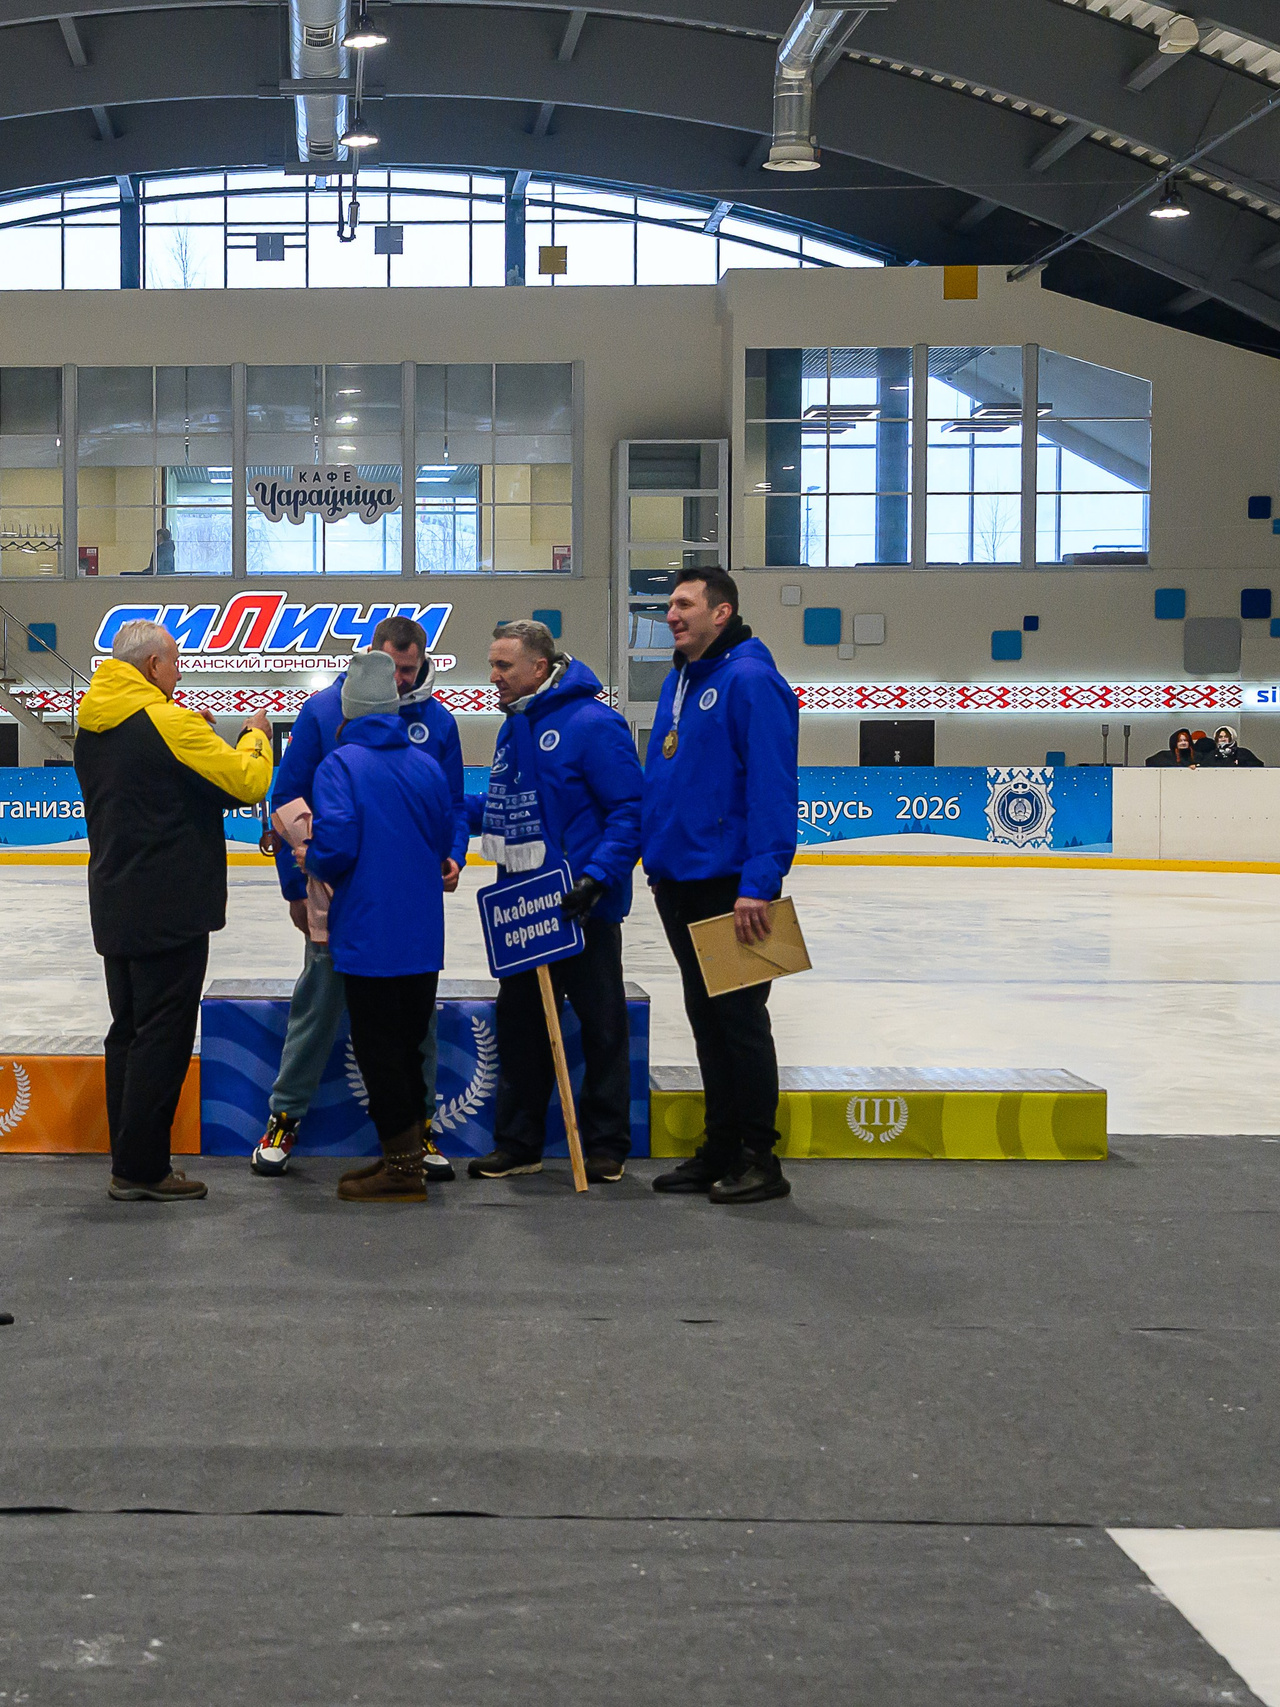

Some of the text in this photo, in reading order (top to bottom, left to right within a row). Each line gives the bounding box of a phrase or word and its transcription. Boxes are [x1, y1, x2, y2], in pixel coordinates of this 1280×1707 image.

[299, 471, 352, 483] КАФЕ
[797, 795, 961, 825] арусь 2026
[493, 890, 563, 928] Академия
[505, 916, 560, 949] сервиса
[856, 1098, 899, 1126] III
